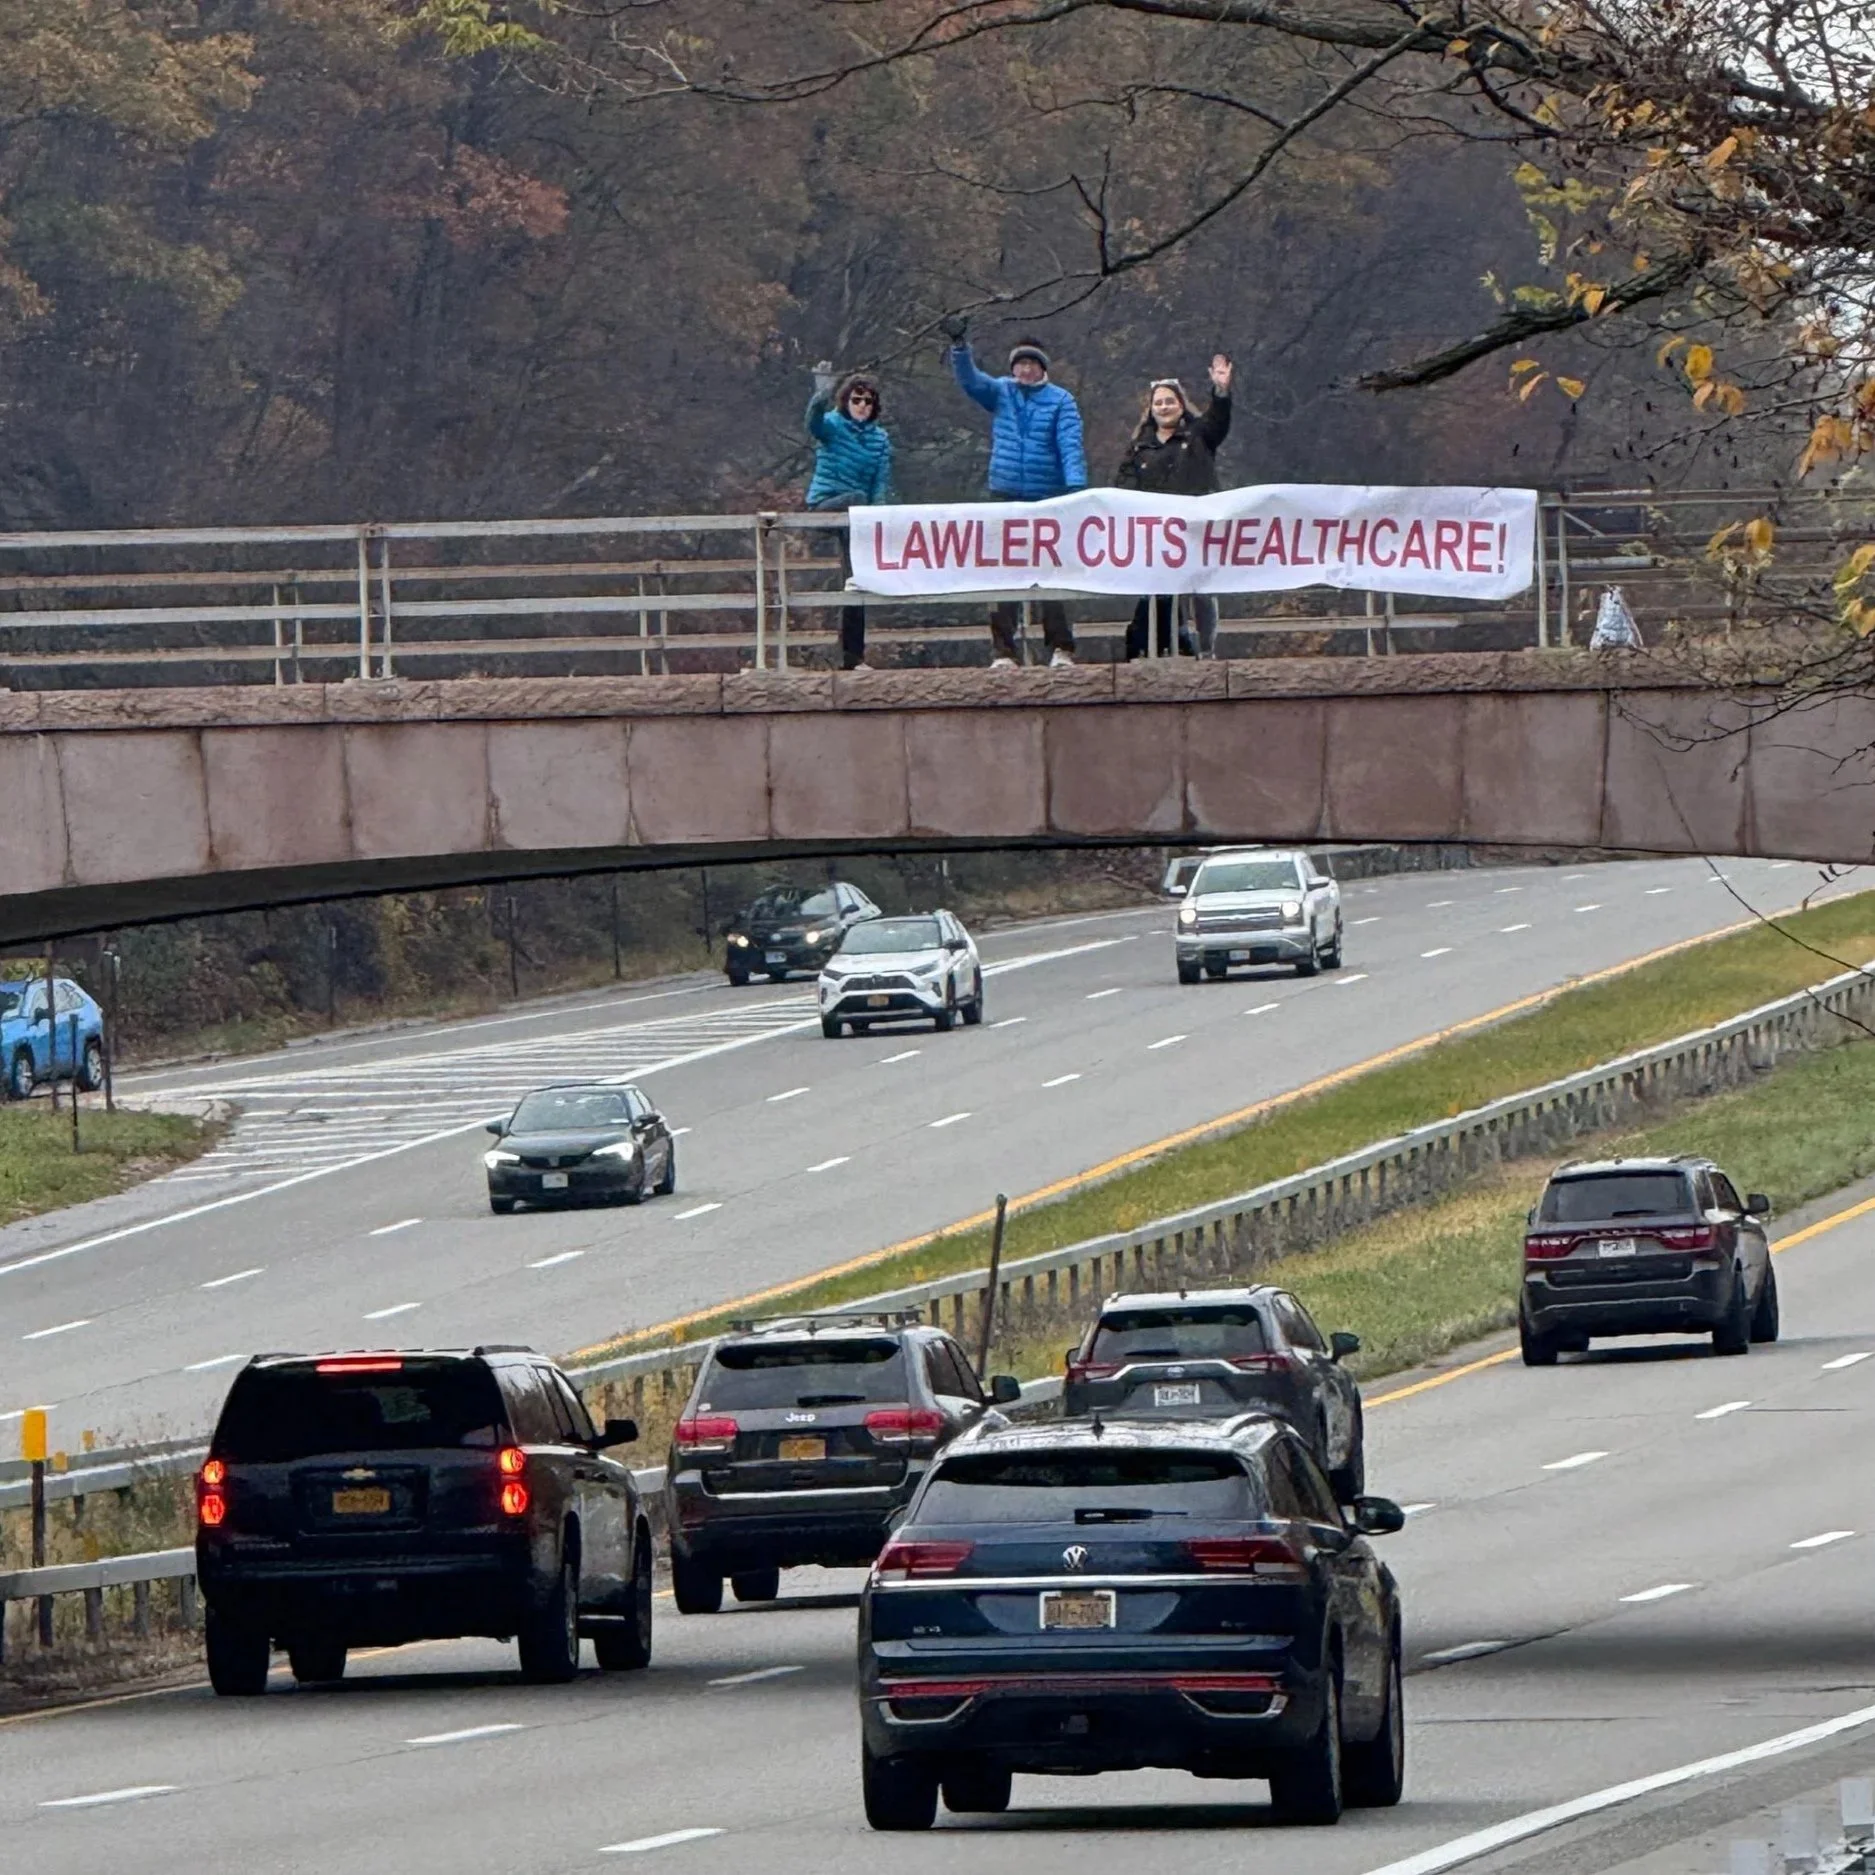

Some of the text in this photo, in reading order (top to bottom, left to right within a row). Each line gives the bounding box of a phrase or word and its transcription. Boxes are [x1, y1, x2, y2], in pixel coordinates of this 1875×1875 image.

[875, 516, 1507, 574] LAWLER CUTS HEALTHCARE!
